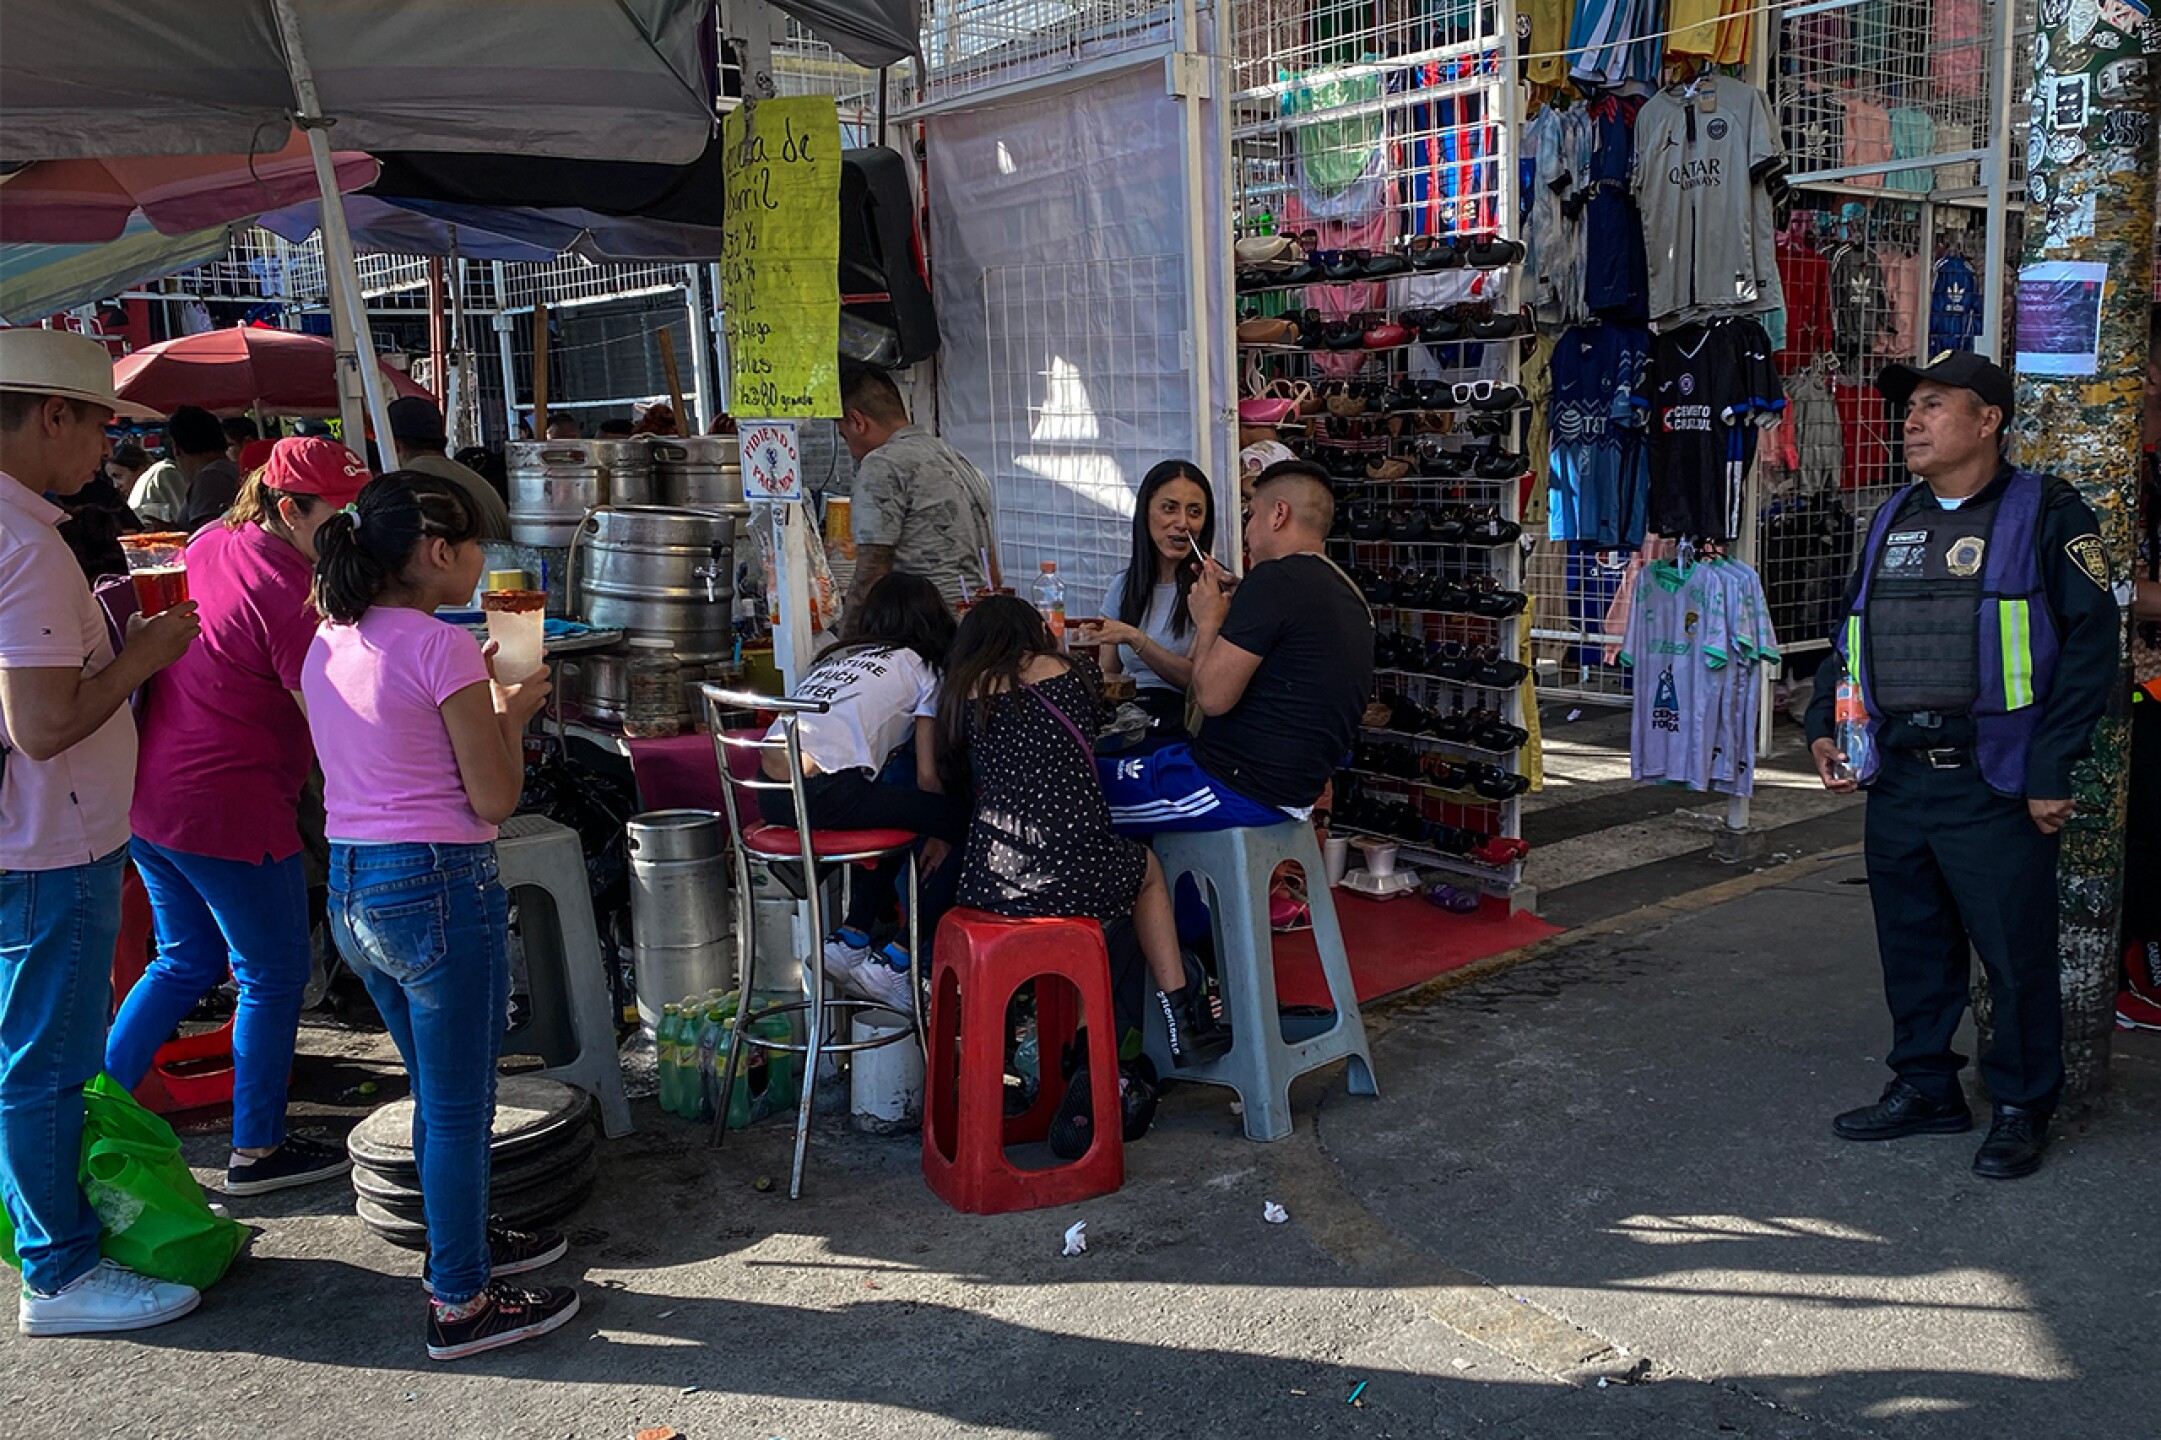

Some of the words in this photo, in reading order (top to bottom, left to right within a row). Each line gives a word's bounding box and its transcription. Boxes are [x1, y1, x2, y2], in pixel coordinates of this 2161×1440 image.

[783, 117, 815, 163] de
[1669, 158, 1720, 185] QATAR
[744, 427, 796, 460] PIDIENDO
